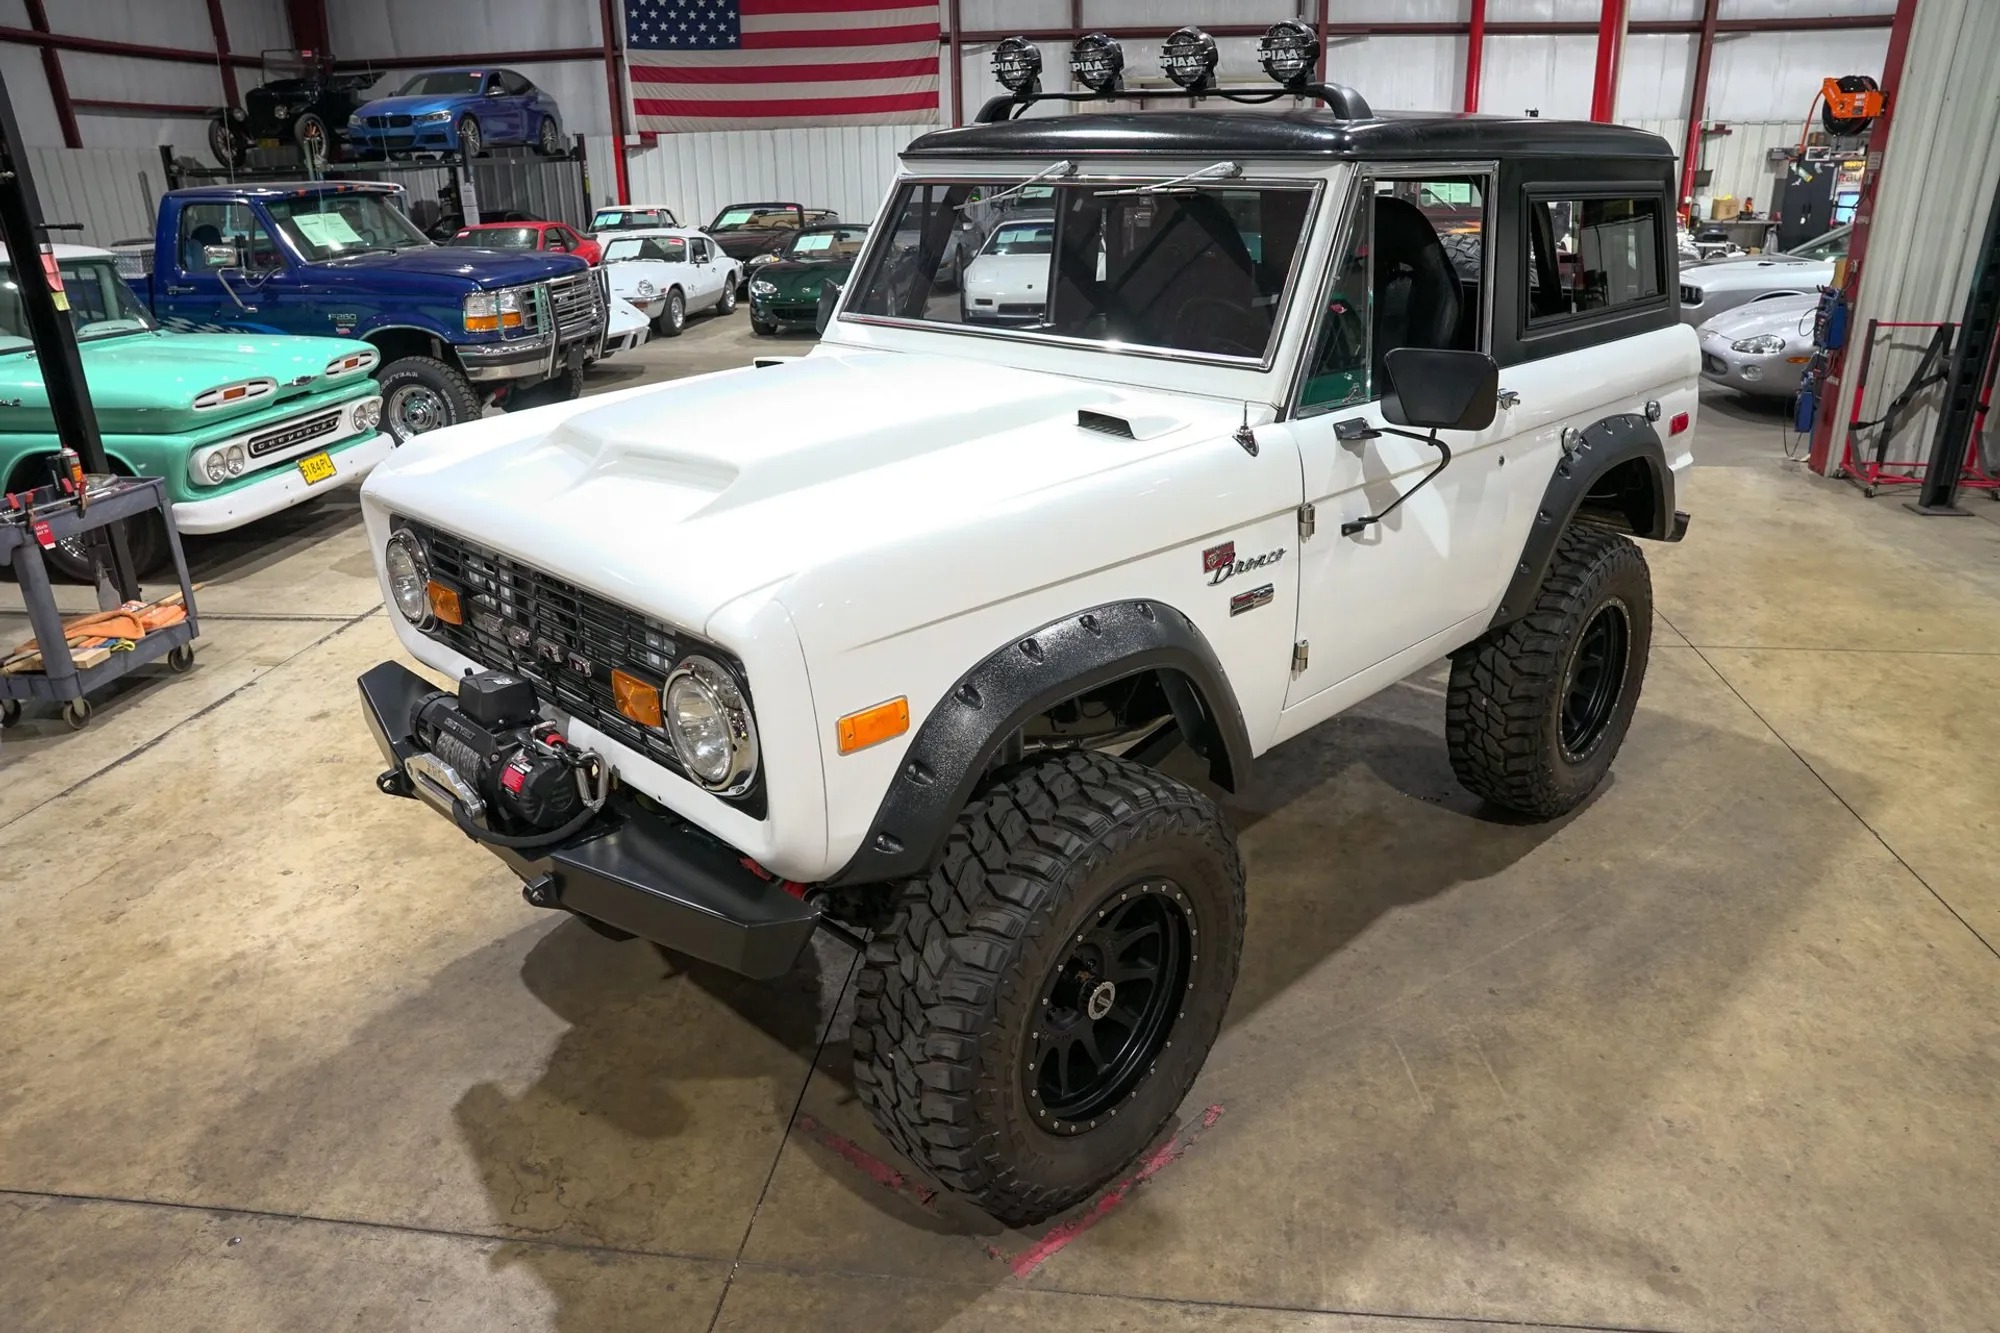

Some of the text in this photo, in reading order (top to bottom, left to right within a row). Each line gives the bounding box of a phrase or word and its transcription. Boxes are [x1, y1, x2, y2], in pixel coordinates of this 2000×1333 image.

[1262, 48, 1299, 61] PIAA
[994, 61, 1021, 72] PIAA
[1071, 60, 1104, 72] PIAA
[1163, 56, 1198, 68] PIAA
[257, 419, 337, 450] CHEVROLET
[1207, 547, 1287, 587] Bronco
